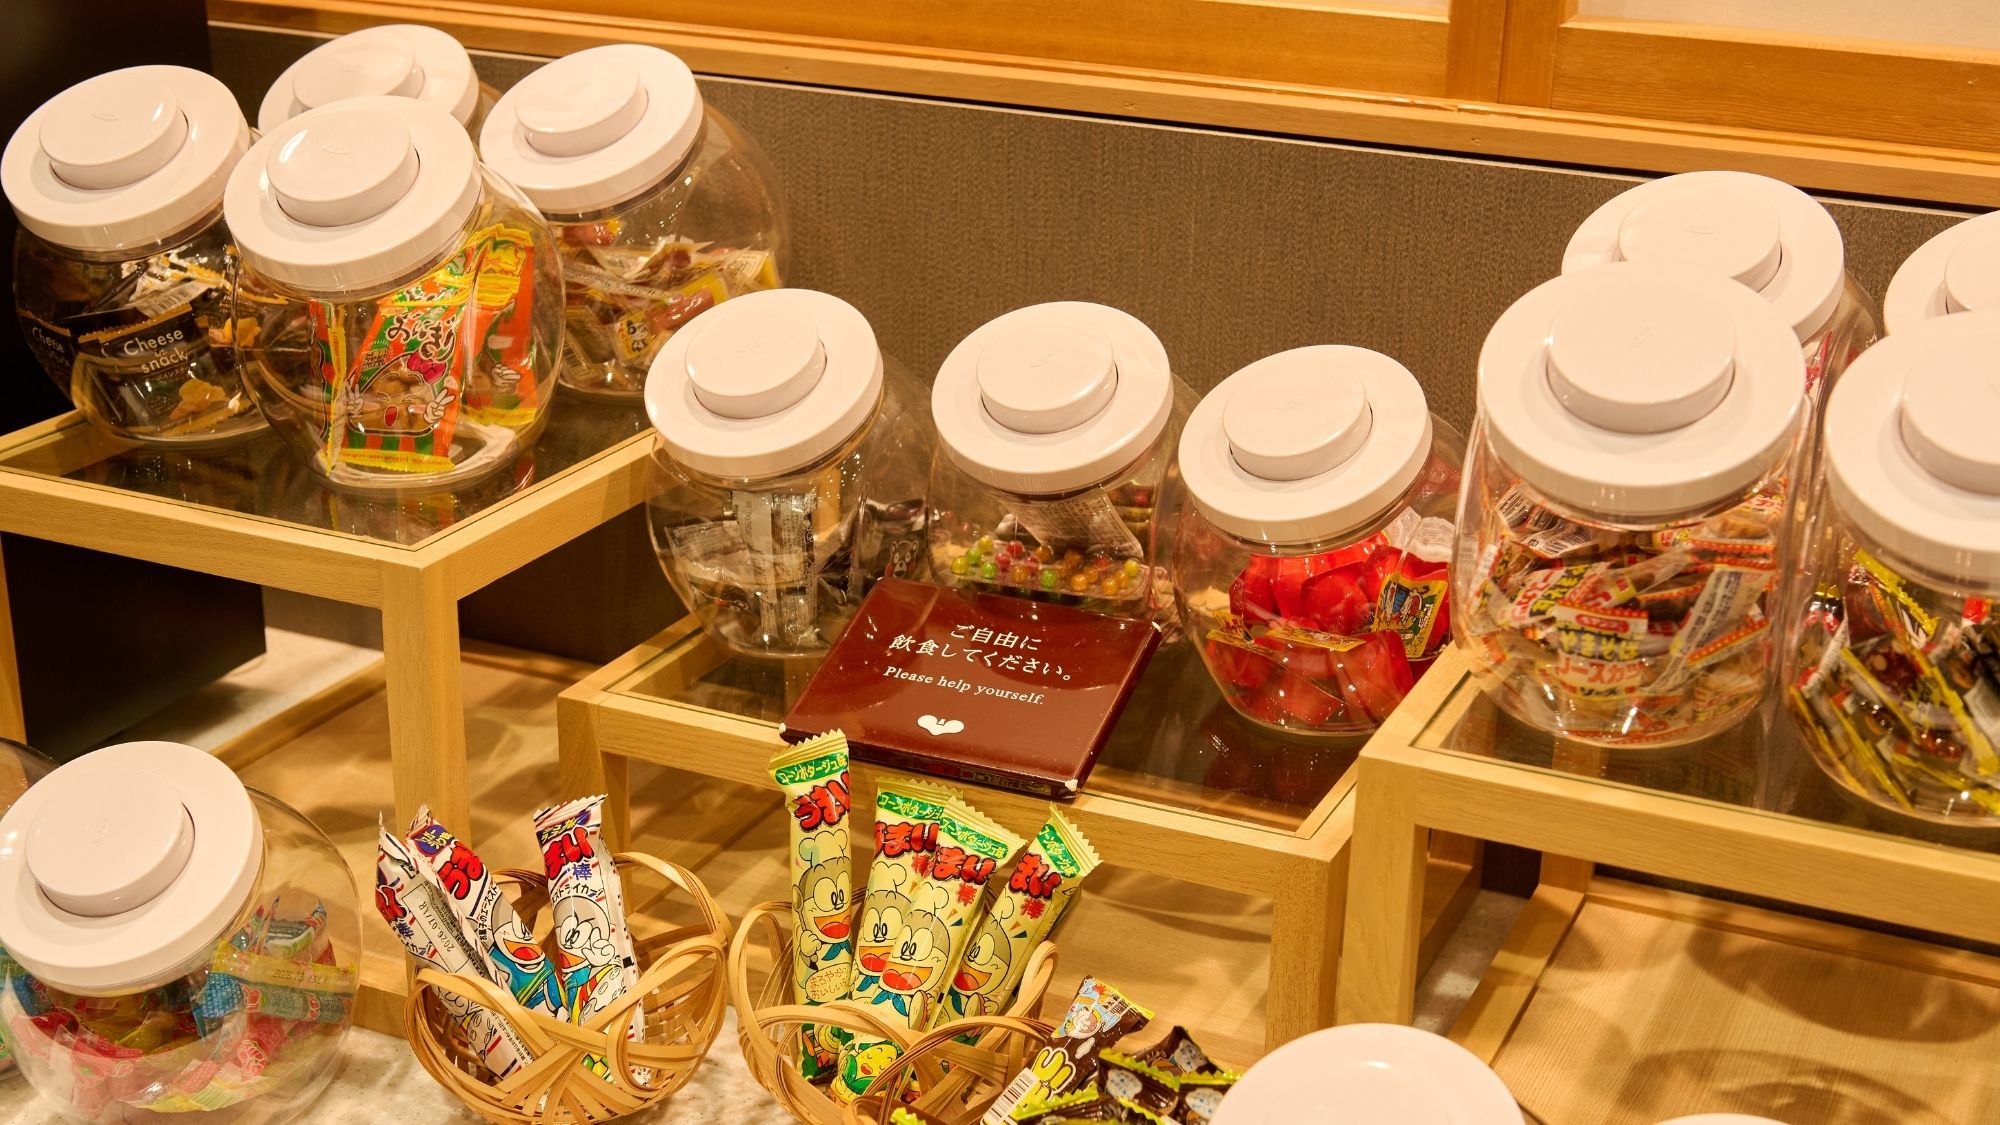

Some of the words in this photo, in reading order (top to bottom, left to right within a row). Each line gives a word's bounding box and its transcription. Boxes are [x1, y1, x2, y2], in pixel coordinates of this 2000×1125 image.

[123, 329, 184, 356] Cheese
[386, 314, 457, 362] おにぎり
[141, 350, 188, 374] snack
[949, 622, 1043, 651] ご自由に
[1559, 631, 1640, 662] やきそば
[889, 633, 1072, 682] 飲食してください。
[883, 666, 934, 685] Please
[937, 676, 971, 694] help
[975, 683, 1046, 705] yourself.
[778, 754, 848, 783] コーンポタージュ味
[939, 817, 1006, 860] コーンポタージュ味
[572, 863, 593, 881] 棒
